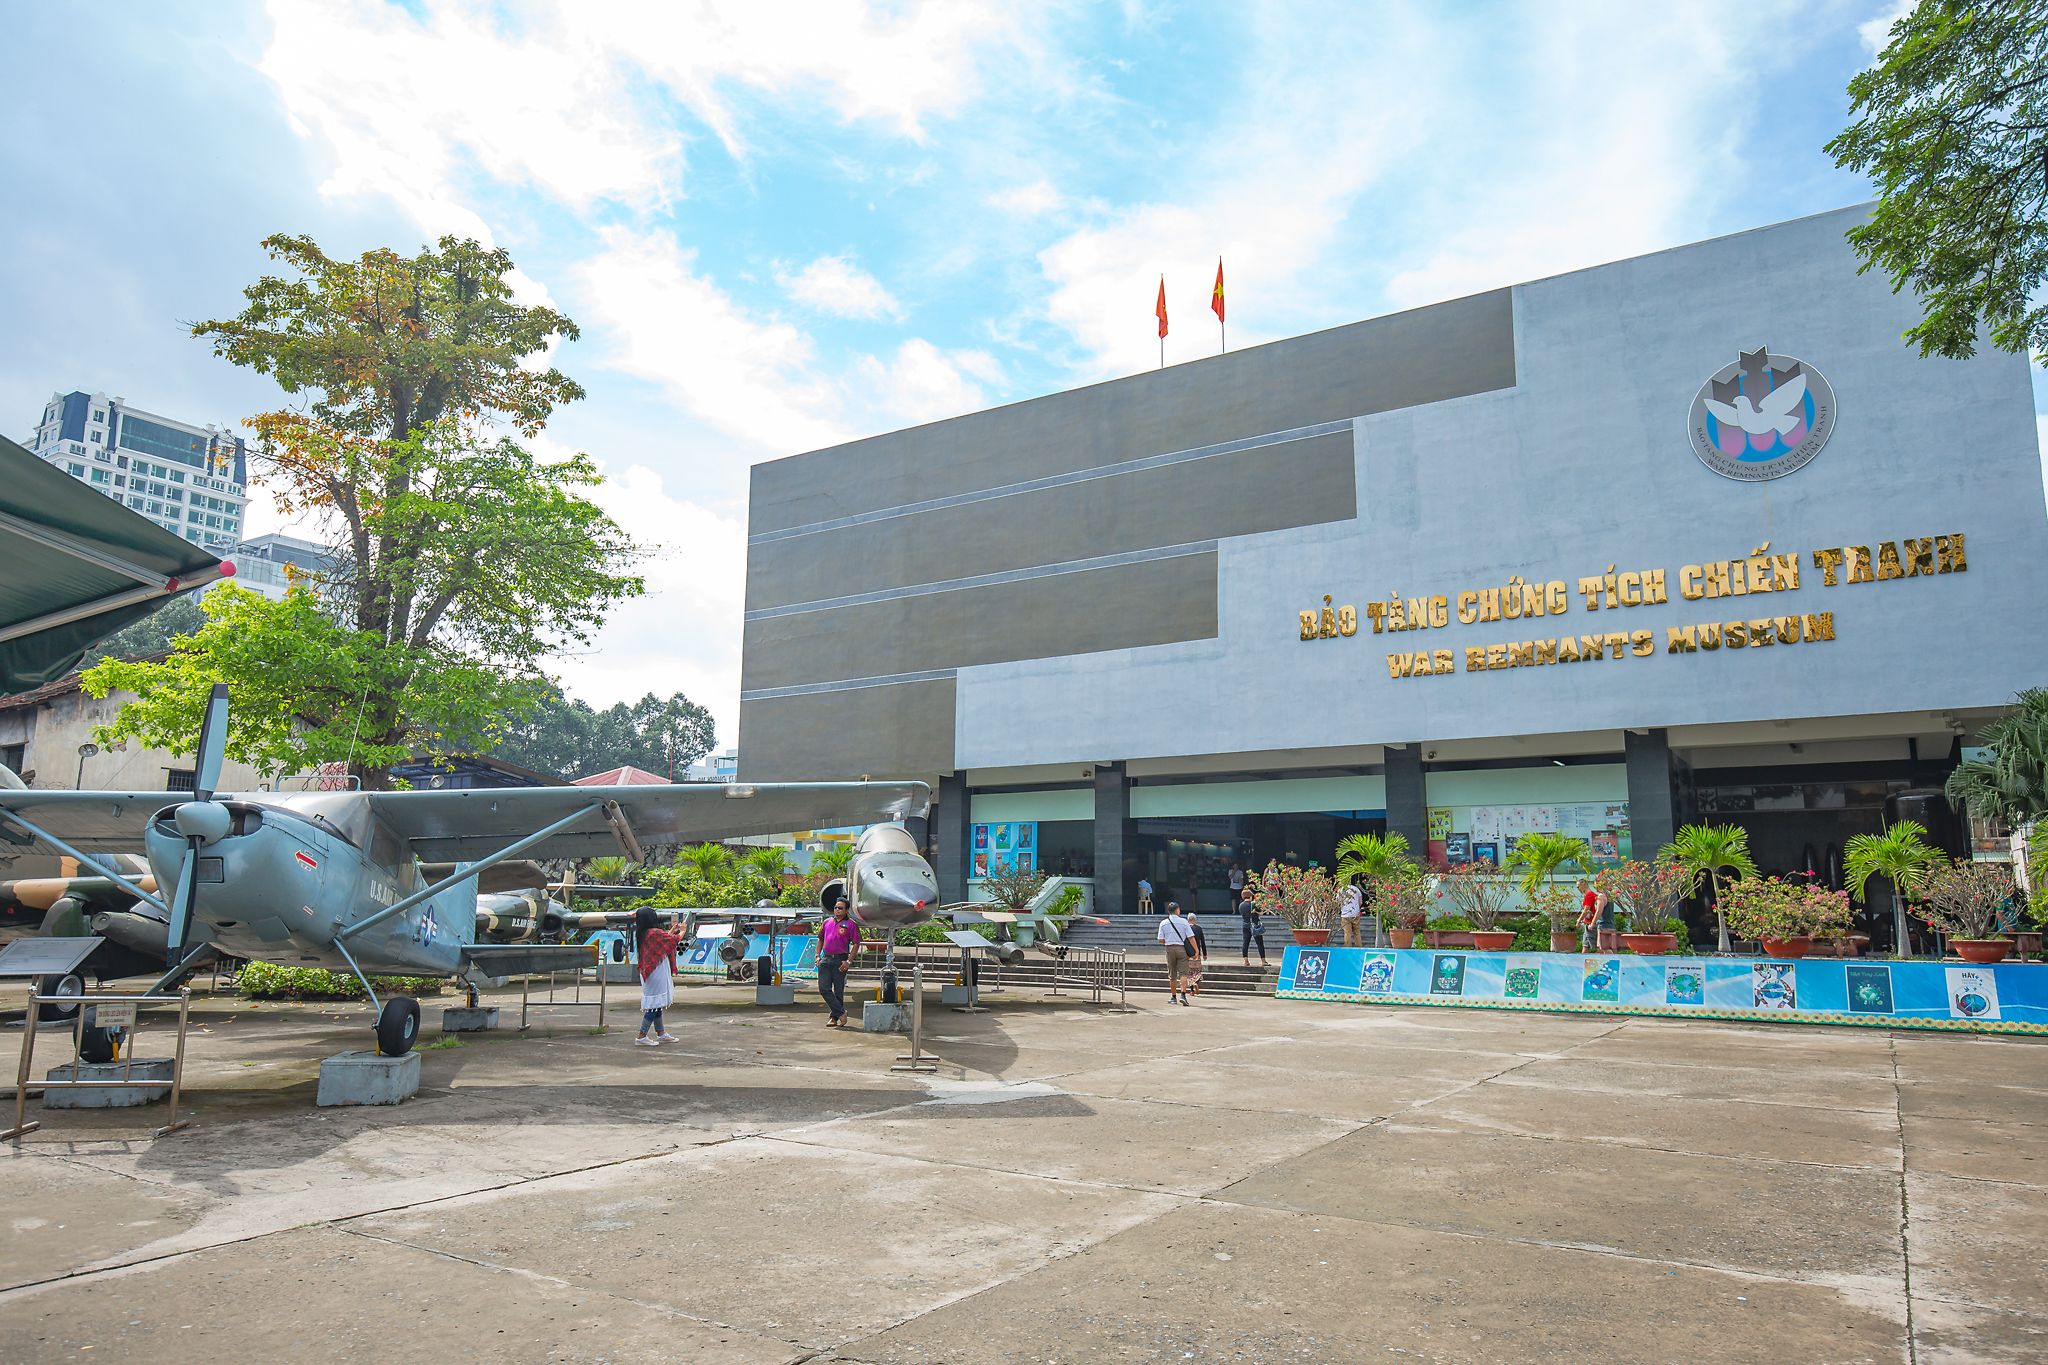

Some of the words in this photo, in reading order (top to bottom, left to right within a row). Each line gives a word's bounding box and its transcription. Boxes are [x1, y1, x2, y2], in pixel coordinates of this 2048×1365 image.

[1708, 458, 1725, 472] WAR
[1726, 469, 1781, 479] REMNANTS
[1784, 442, 1821, 471] MUSEUM
[1299, 594, 1357, 641] BẢO
[1367, 591, 1448, 633] TÀNG
[1457, 575, 1567, 624] CHỨNG
[1578, 564, 1668, 611] TÍCH
[1679, 541, 1800, 600] CHIẾN
[1812, 532, 1968, 587] TRANH
[1386, 649, 1455, 678] WAR
[1465, 629, 1654, 672] REMNANTS
[1667, 611, 1836, 654] MUSEUM
